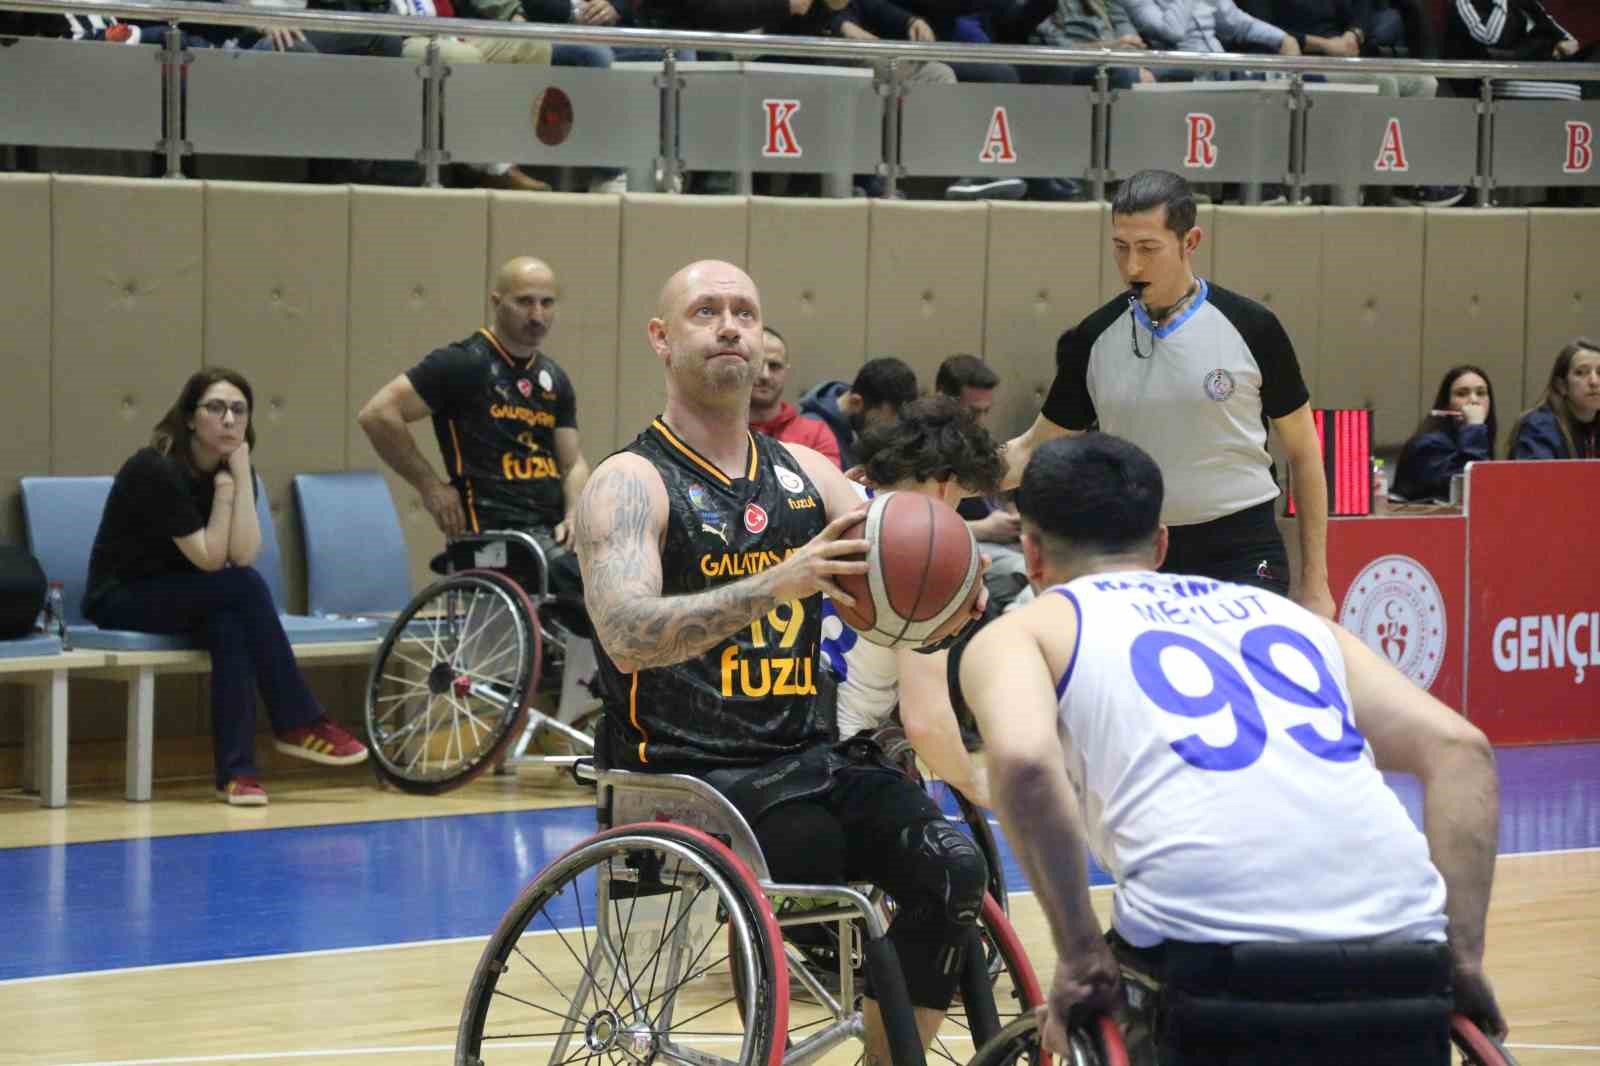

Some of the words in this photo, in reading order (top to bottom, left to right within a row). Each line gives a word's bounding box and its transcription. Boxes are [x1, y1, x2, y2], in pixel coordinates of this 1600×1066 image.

[763, 99, 801, 157] K
[979, 106, 1016, 163] A
[1185, 112, 1217, 168] R
[1375, 118, 1408, 171] A
[1563, 120, 1592, 173] B
[1131, 594, 1268, 625] MELUT
[720, 644, 817, 697] fuzu
[1130, 625, 1366, 772] 99
